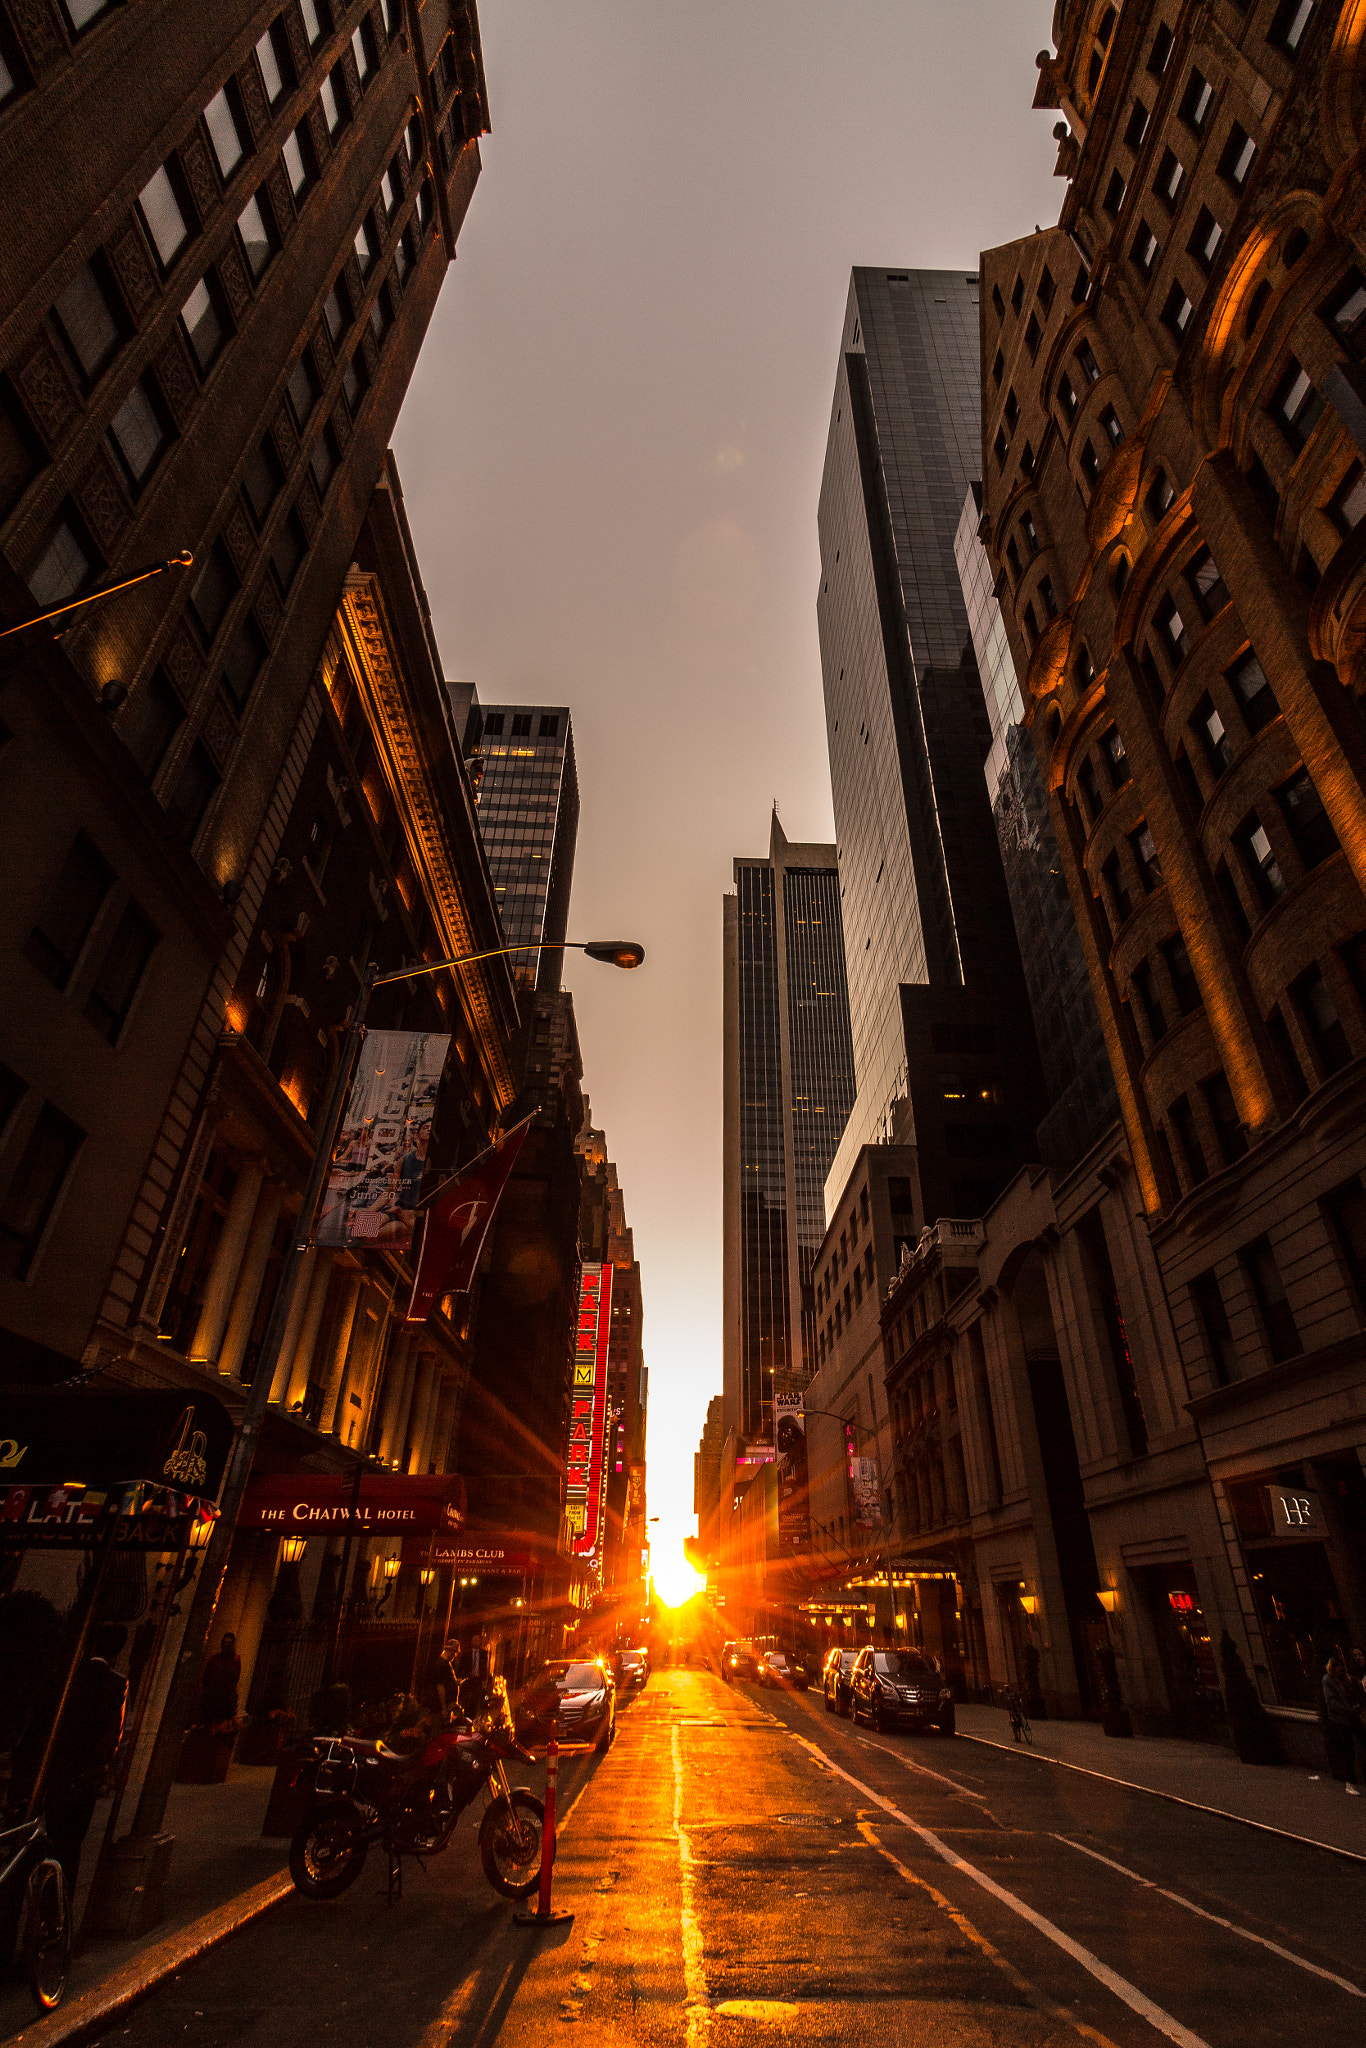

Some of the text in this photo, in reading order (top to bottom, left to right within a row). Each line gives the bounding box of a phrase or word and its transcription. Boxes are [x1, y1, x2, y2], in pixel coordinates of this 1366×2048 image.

[366, 1076, 412, 1171] YOGA
[350, 1190, 378, 1200] June
[577, 1274, 598, 1350] PARK
[568, 1400, 591, 1486] PARK
[260, 1503, 417, 1521] THE CHATWAL HOTEL
[435, 1548, 473, 1558] LAMBS
[475, 1548, 505, 1559] CLUB
